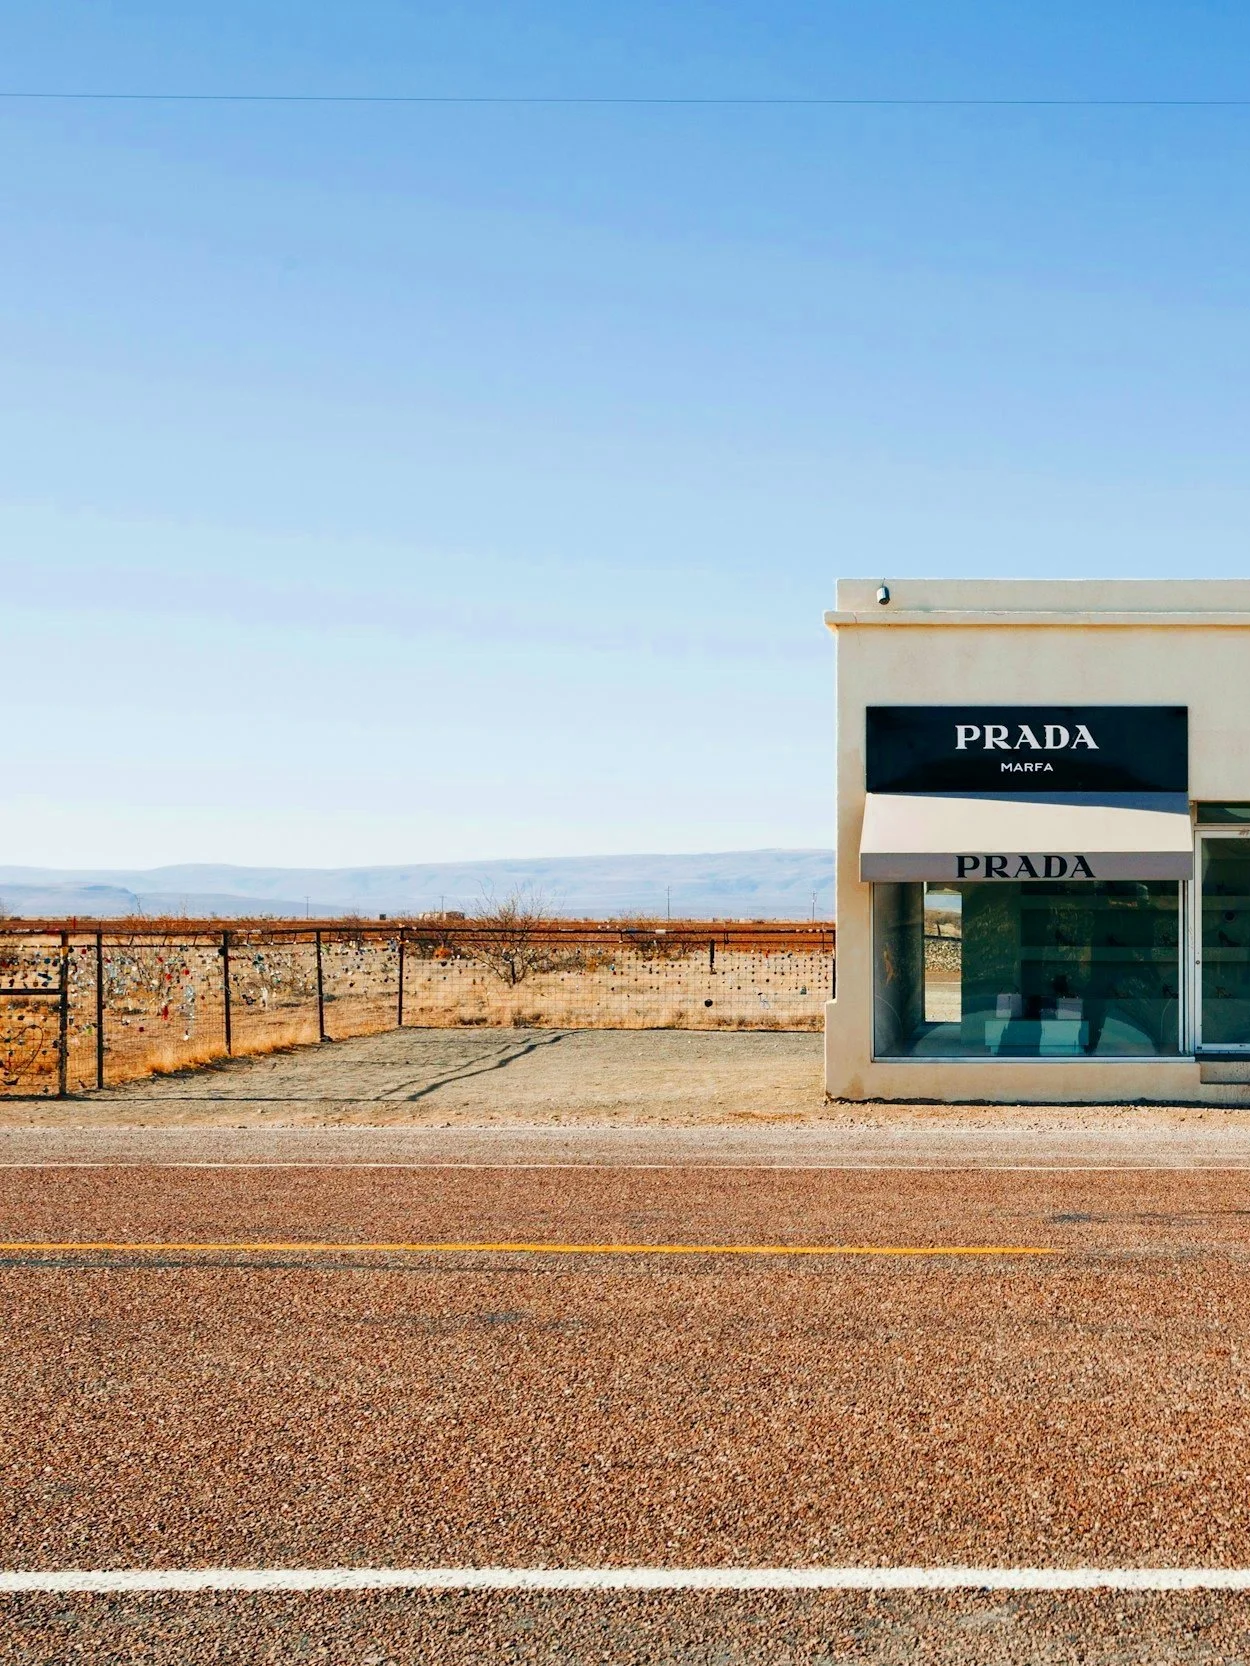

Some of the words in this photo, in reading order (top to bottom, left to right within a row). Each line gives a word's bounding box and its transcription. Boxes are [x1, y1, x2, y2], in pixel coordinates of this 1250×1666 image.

[955, 724, 1100, 750] PRADA
[1000, 762, 1054, 773] MARFA
[956, 855, 1096, 879] PRADA
